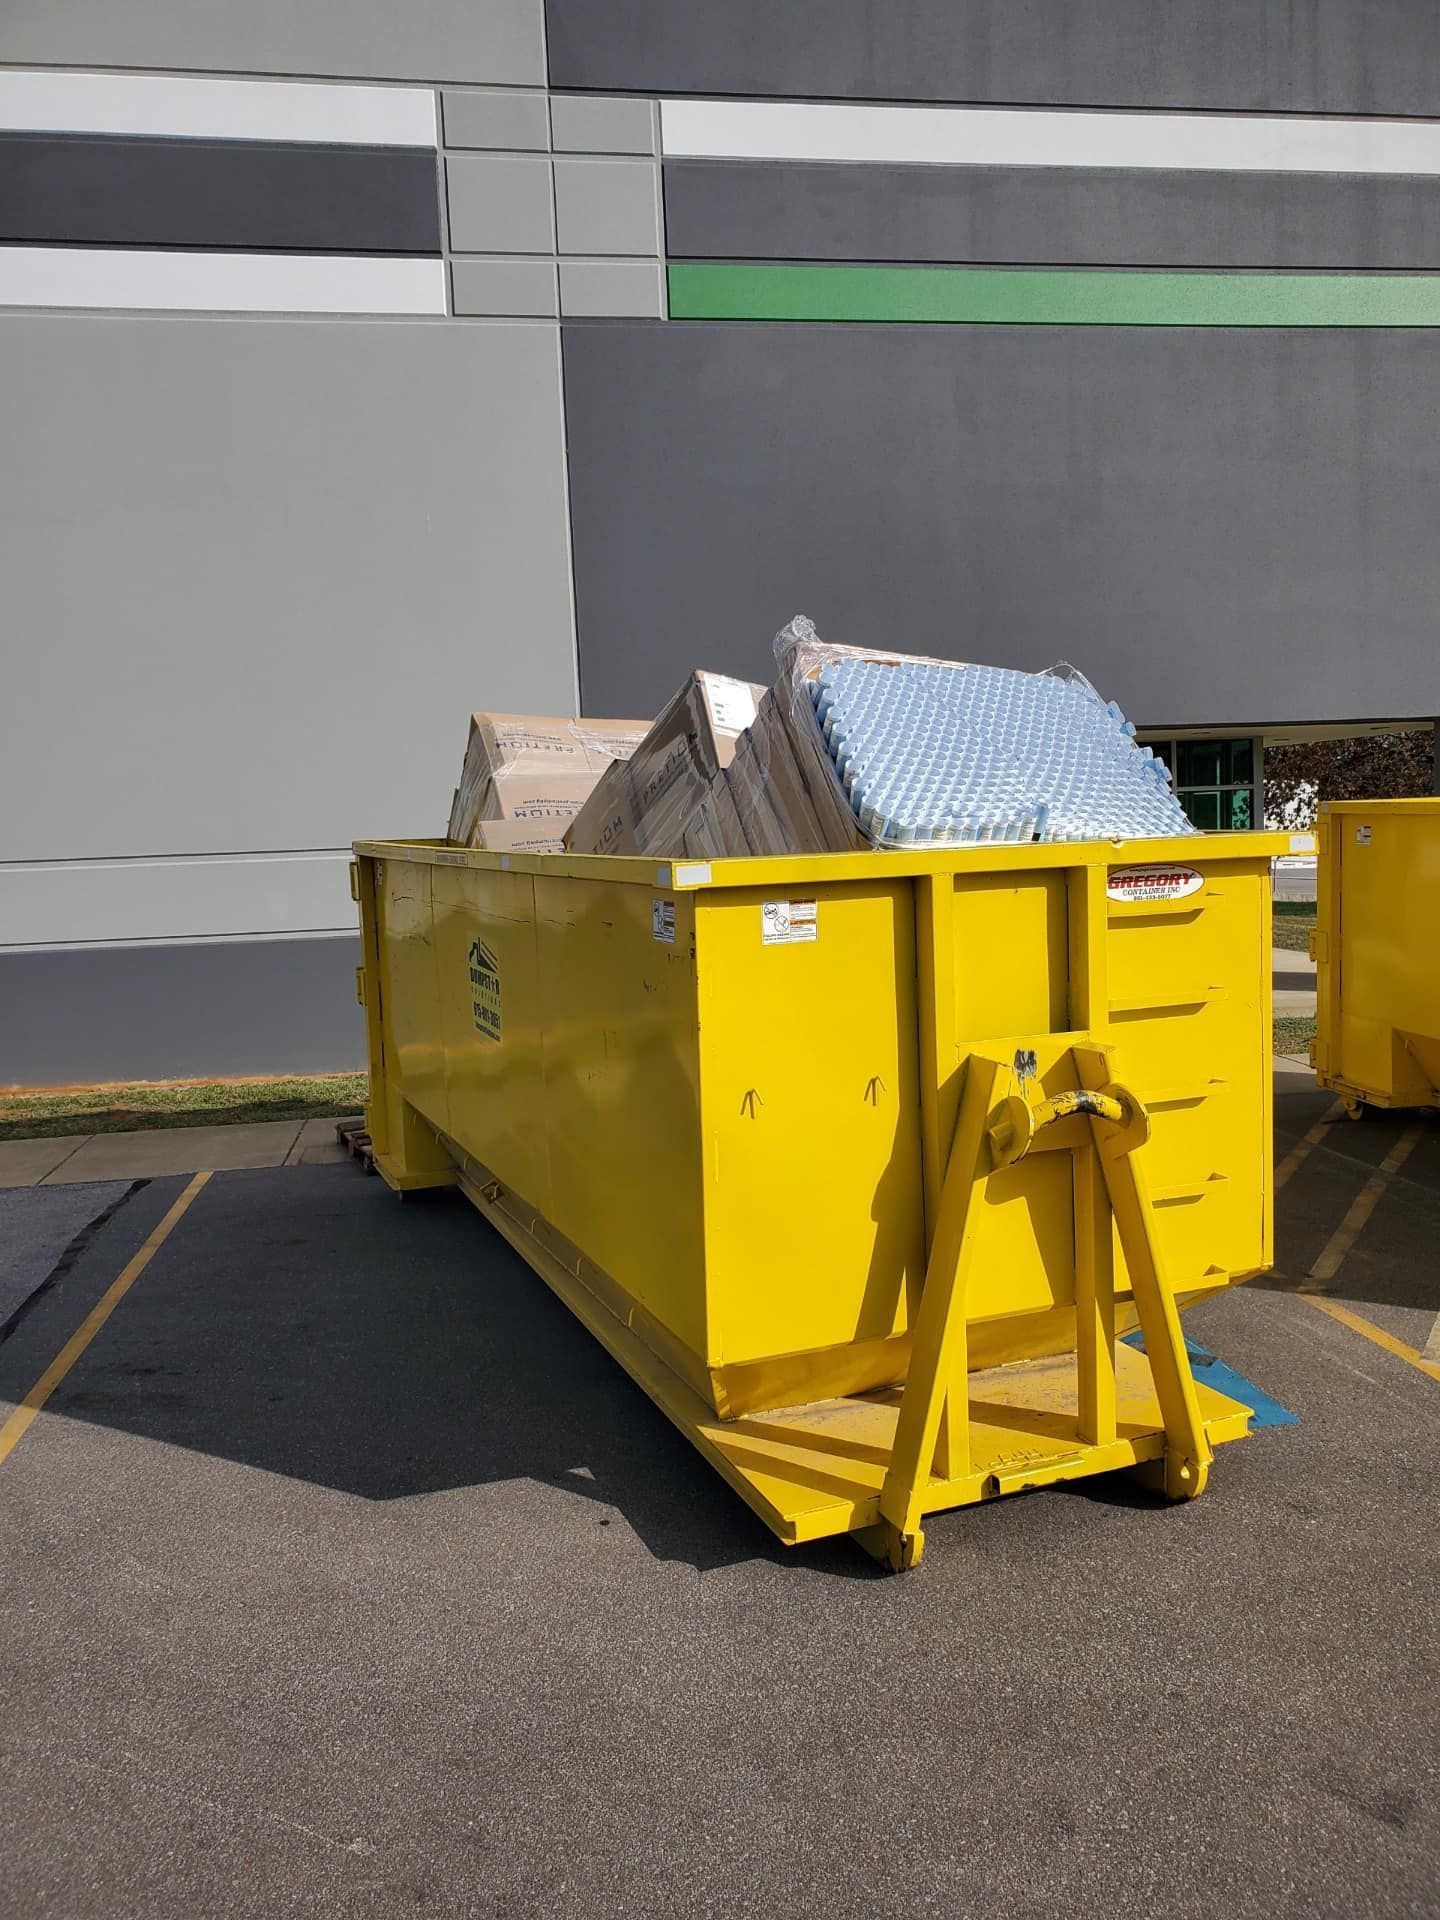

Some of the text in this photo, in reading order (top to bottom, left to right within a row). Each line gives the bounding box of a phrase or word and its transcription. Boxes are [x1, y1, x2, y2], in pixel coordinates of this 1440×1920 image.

[1108, 872, 1191, 890] GREGORY
[1122, 886, 1181, 897] CONTAINER INC
